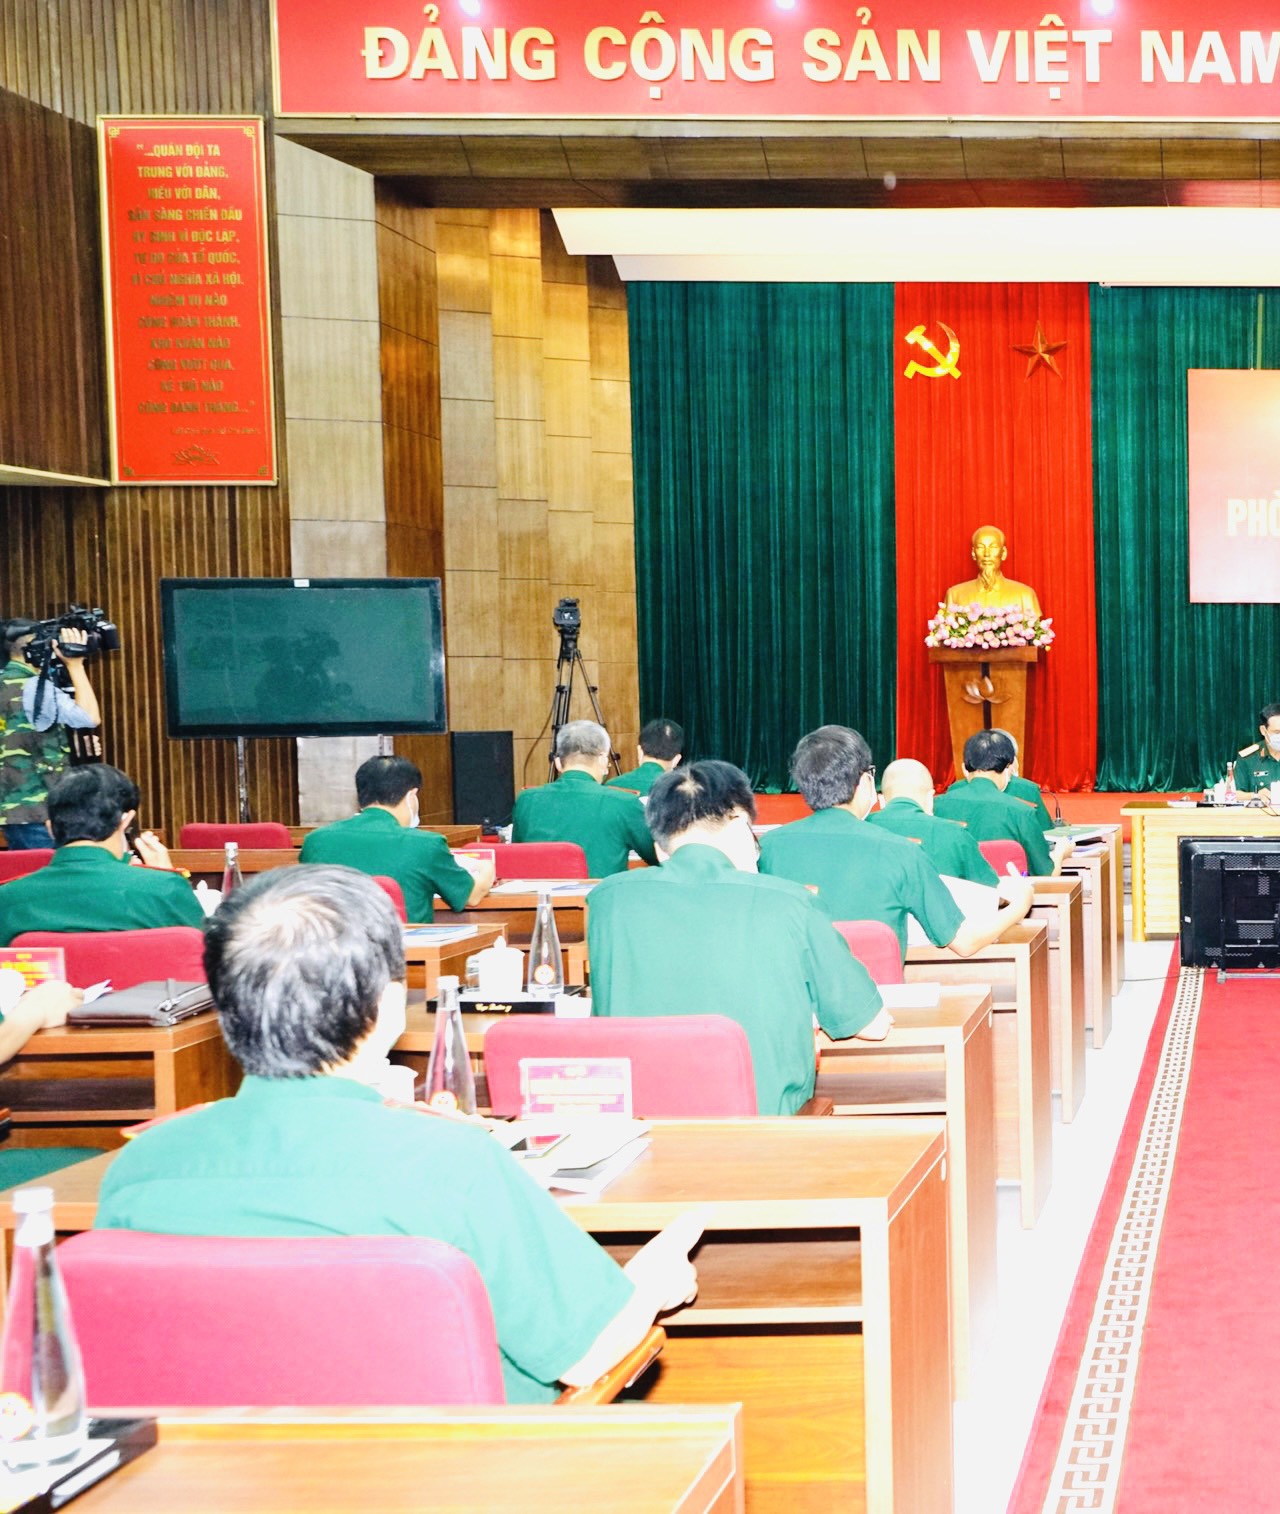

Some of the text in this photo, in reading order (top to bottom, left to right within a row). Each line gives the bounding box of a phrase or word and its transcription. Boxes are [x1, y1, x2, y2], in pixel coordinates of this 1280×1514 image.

[362, 4, 556, 81] ĐẢNG
[583, 10, 775, 99] CỘNG
[802, 7, 941, 82] SẢN
[966, 14, 1112, 99] VIỆT
